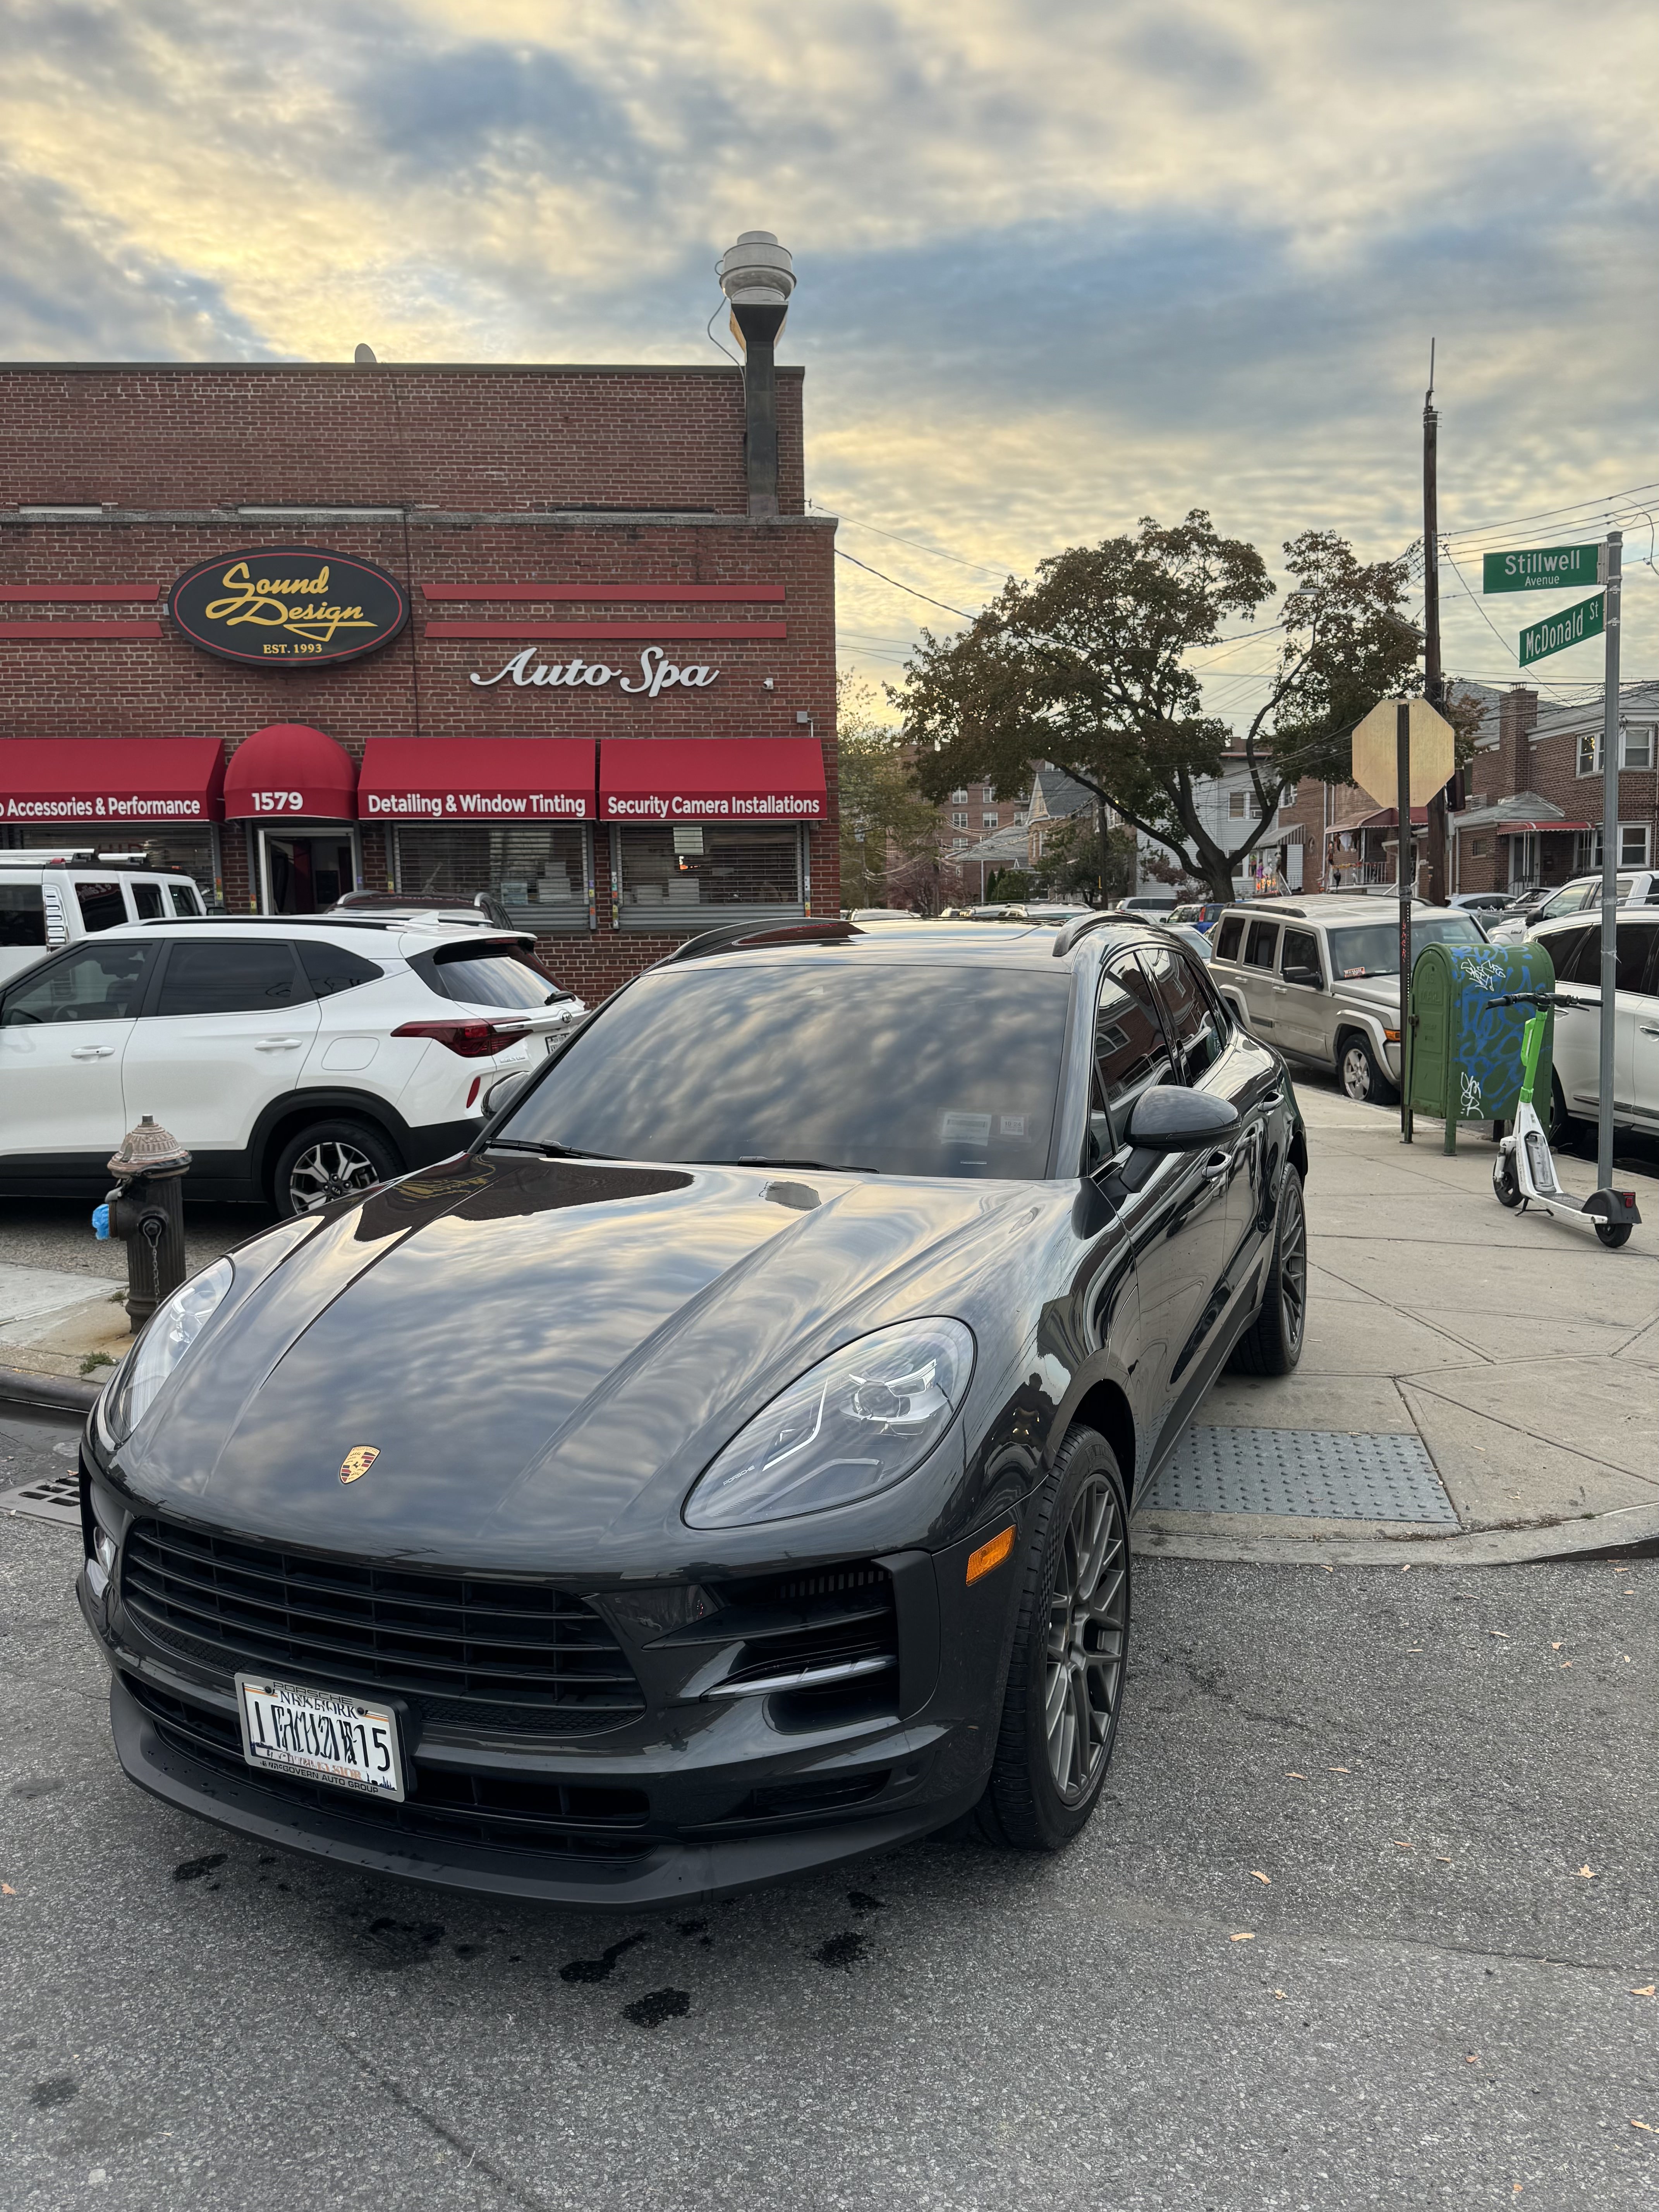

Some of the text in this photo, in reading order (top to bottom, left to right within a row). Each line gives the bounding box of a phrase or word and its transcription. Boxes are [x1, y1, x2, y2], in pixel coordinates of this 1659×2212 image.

[1505, 550, 1580, 575] Stillwell
[223, 562, 330, 598] Sound
[1525, 575, 1560, 586] Avenue
[206, 597, 378, 642] Design
[1526, 601, 1599, 659] McDonald St
[263, 643, 322, 654] EST. 1993
[470, 646, 720, 697] Auto Spa
[7, 796, 93, 816] Accessories
[95, 797, 106, 815] &
[108, 795, 200, 815] Performance
[252, 792, 303, 811] 1579
[368, 794, 586, 818] Detailing & Window Tinting
[608, 795, 820, 818] Security Camera Installations
[723, 1465, 755, 1486] PORSCHE
[273, 1682, 353, 1705] PORSCHE
[322, 1774, 345, 1785] AUTO
[348, 1781, 378, 1793] GROUP
